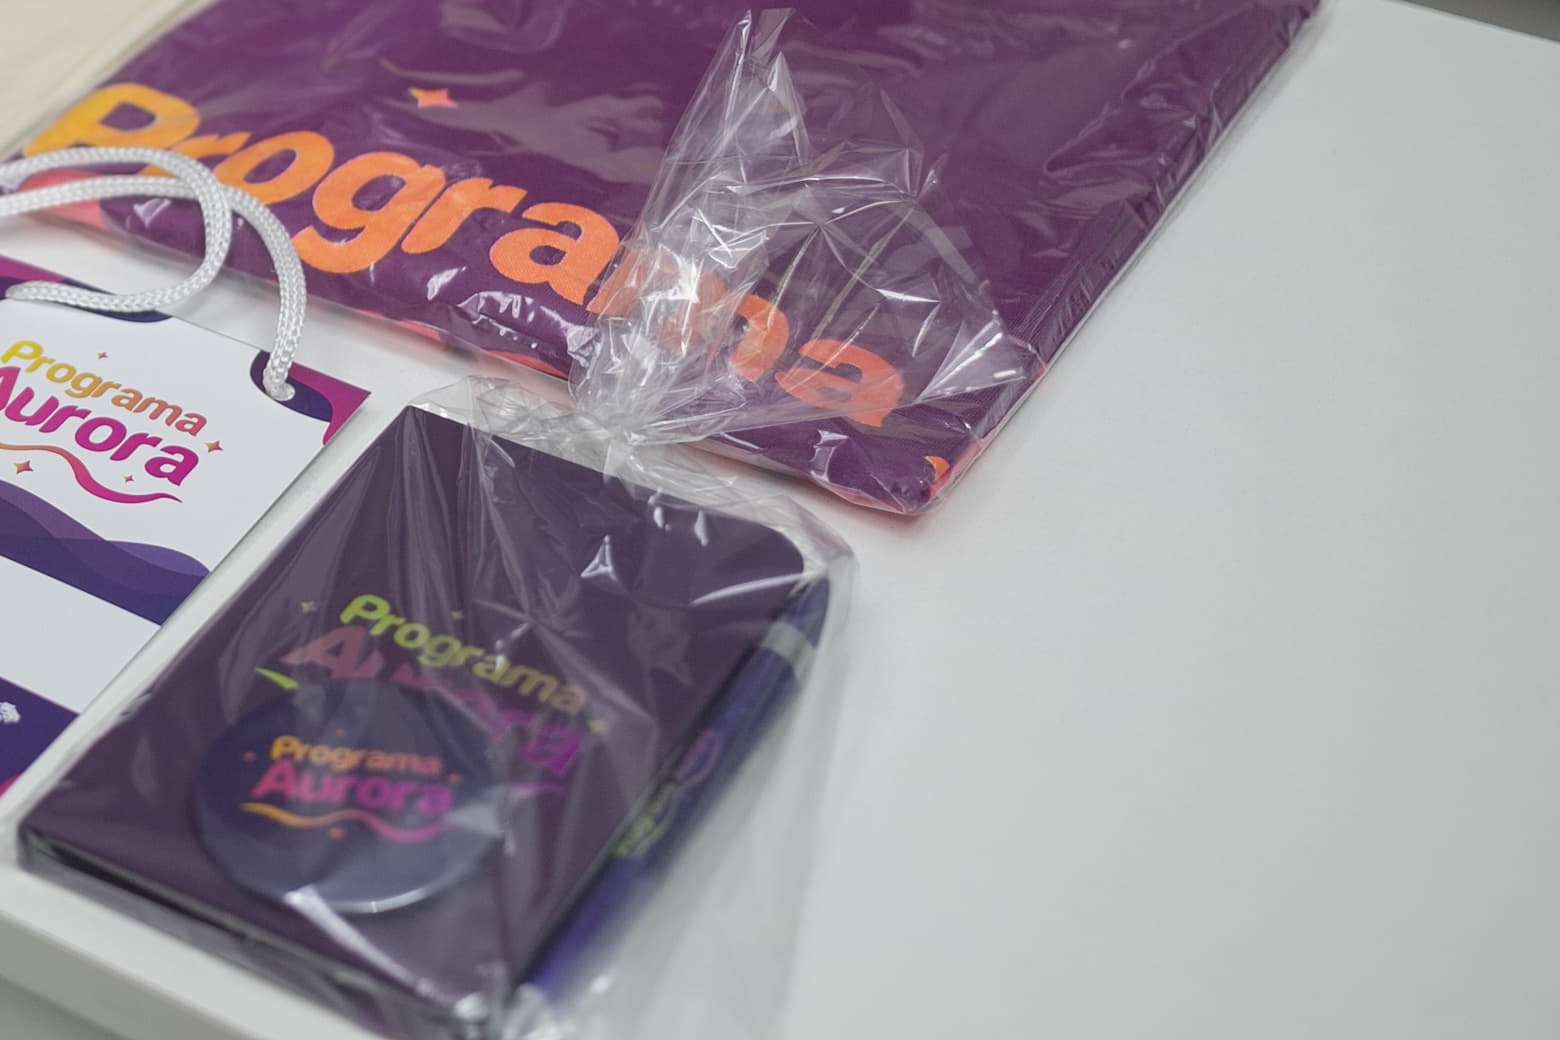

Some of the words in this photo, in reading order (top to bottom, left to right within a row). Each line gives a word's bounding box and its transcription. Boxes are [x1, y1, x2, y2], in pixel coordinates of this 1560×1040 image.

[0, 339, 208, 437] Programa
[339, 594, 591, 716] Programa
[250, 759, 454, 815] Aurora
[269, 734, 443, 776] Programa
